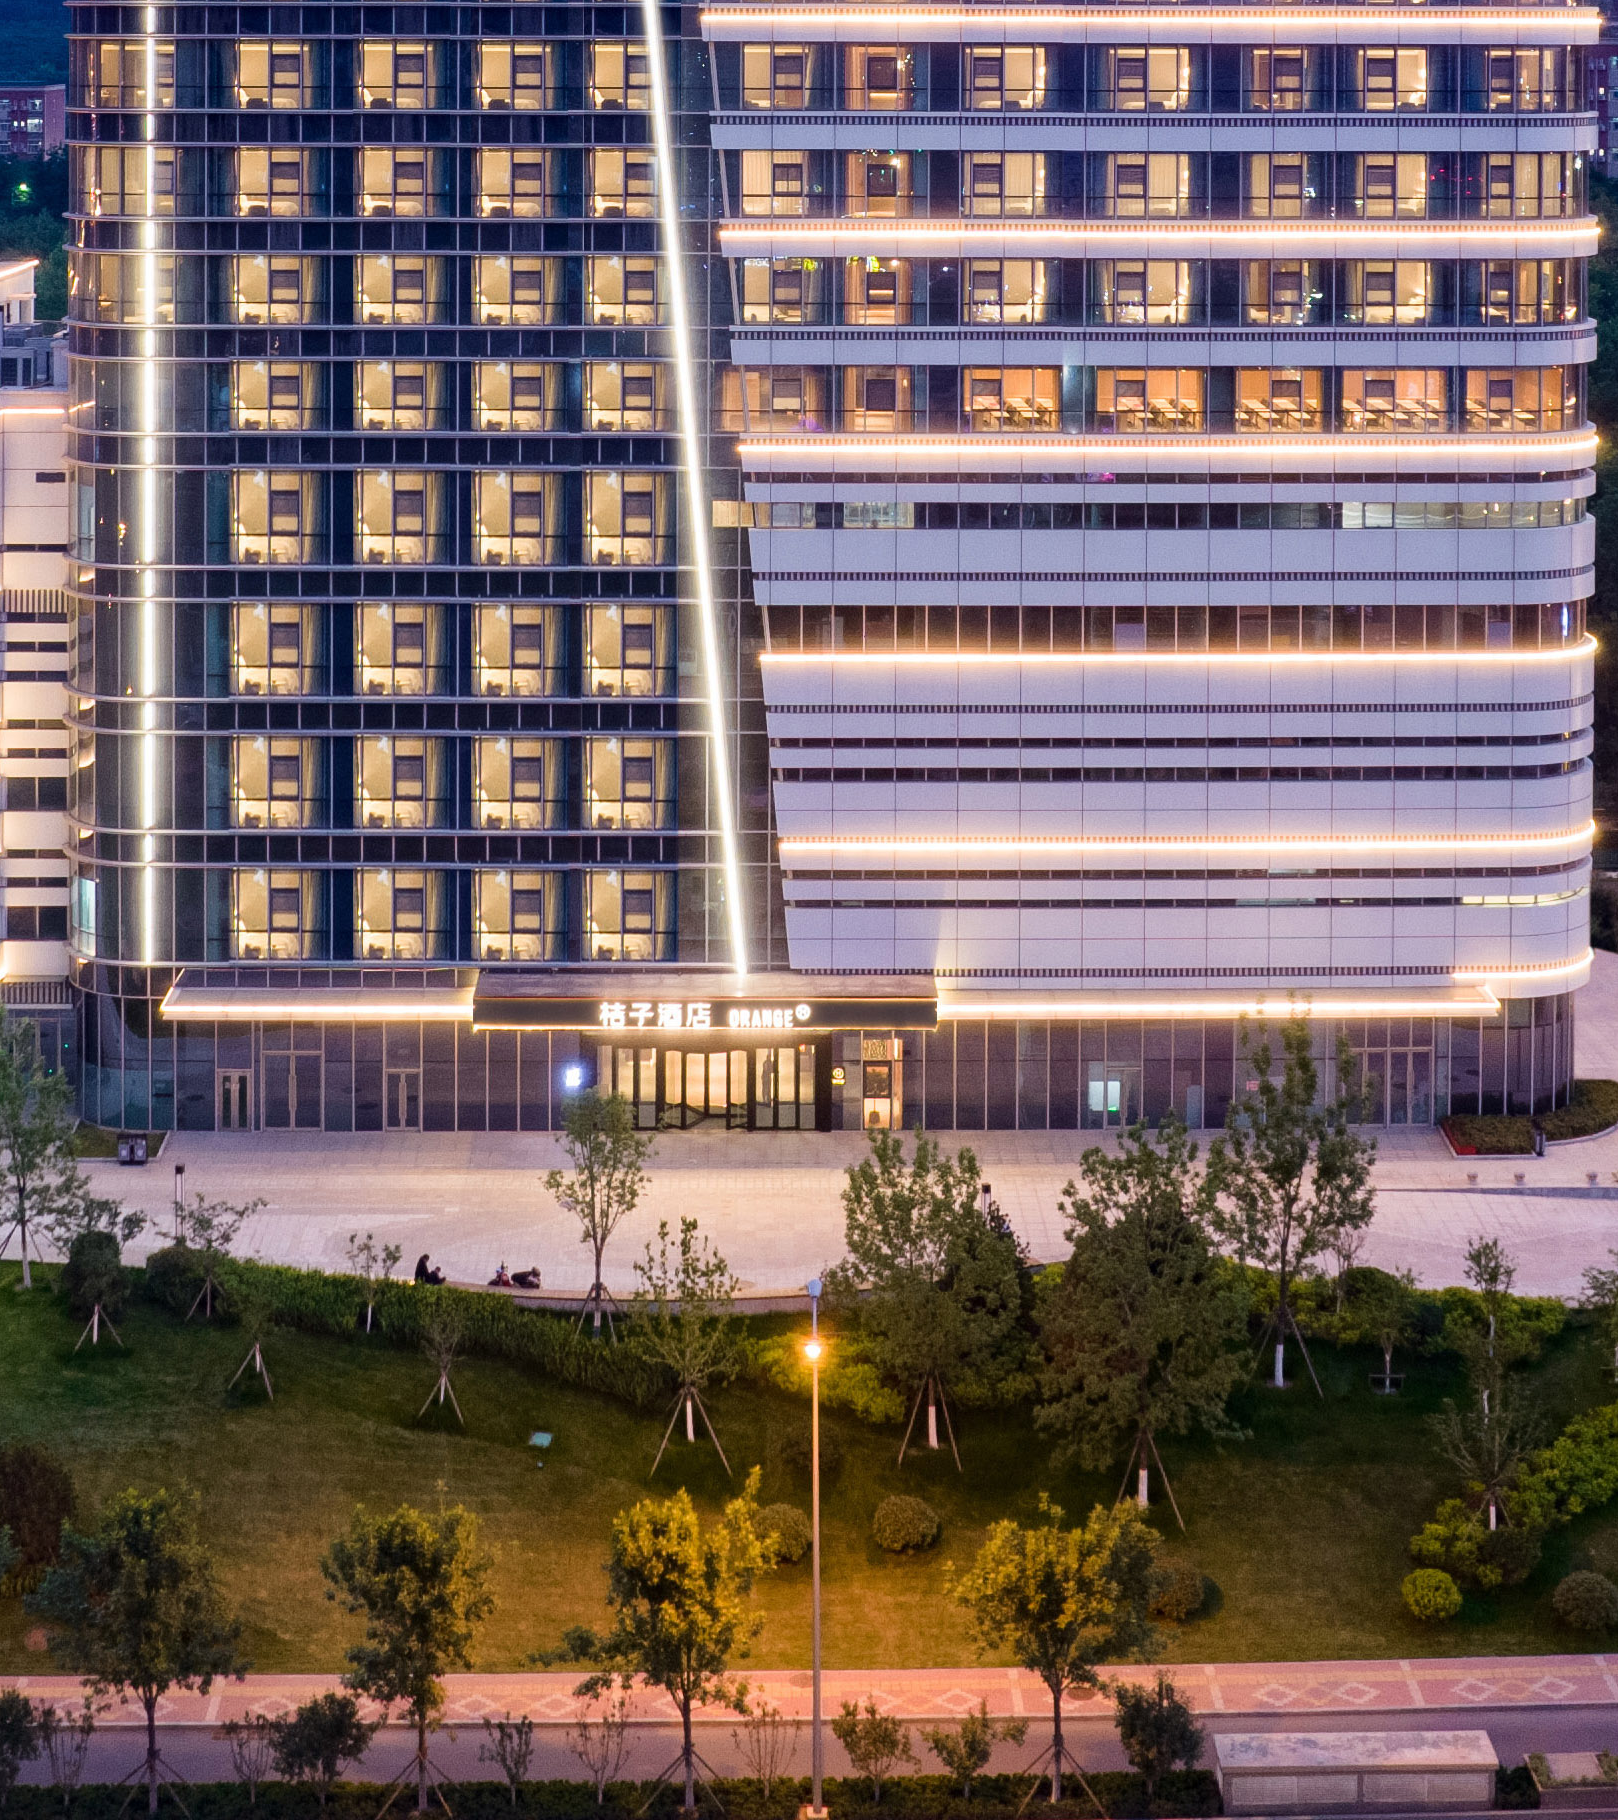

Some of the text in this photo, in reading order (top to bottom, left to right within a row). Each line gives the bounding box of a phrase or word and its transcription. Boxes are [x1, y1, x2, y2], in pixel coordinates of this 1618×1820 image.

[597, 1002, 712, 1027] 桔子酒店
[728, 1008, 794, 1028] ORANGE
